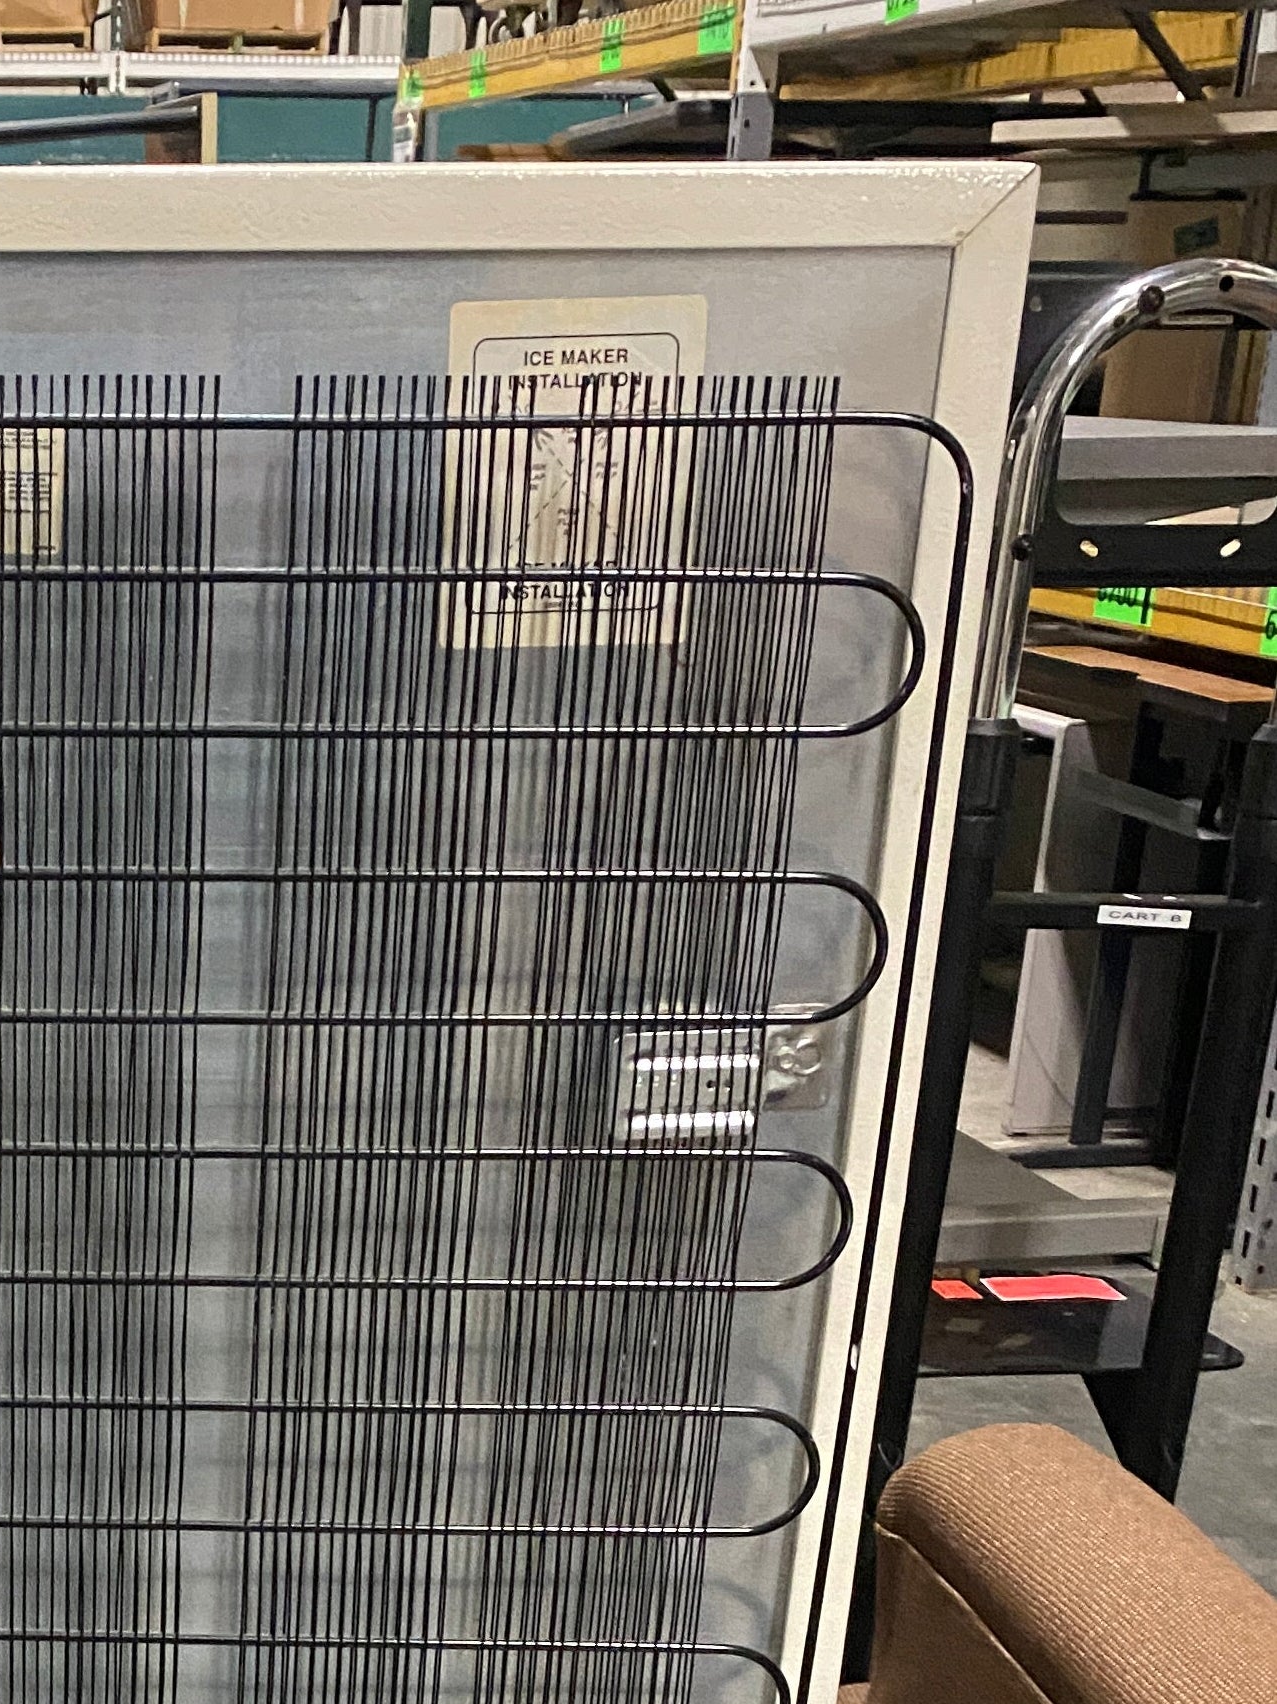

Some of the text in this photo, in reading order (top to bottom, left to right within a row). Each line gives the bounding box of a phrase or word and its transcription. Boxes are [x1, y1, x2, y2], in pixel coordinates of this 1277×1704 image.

[524, 348, 629, 366] ICE MAKER
[1108, 910, 1182, 923] CART B
